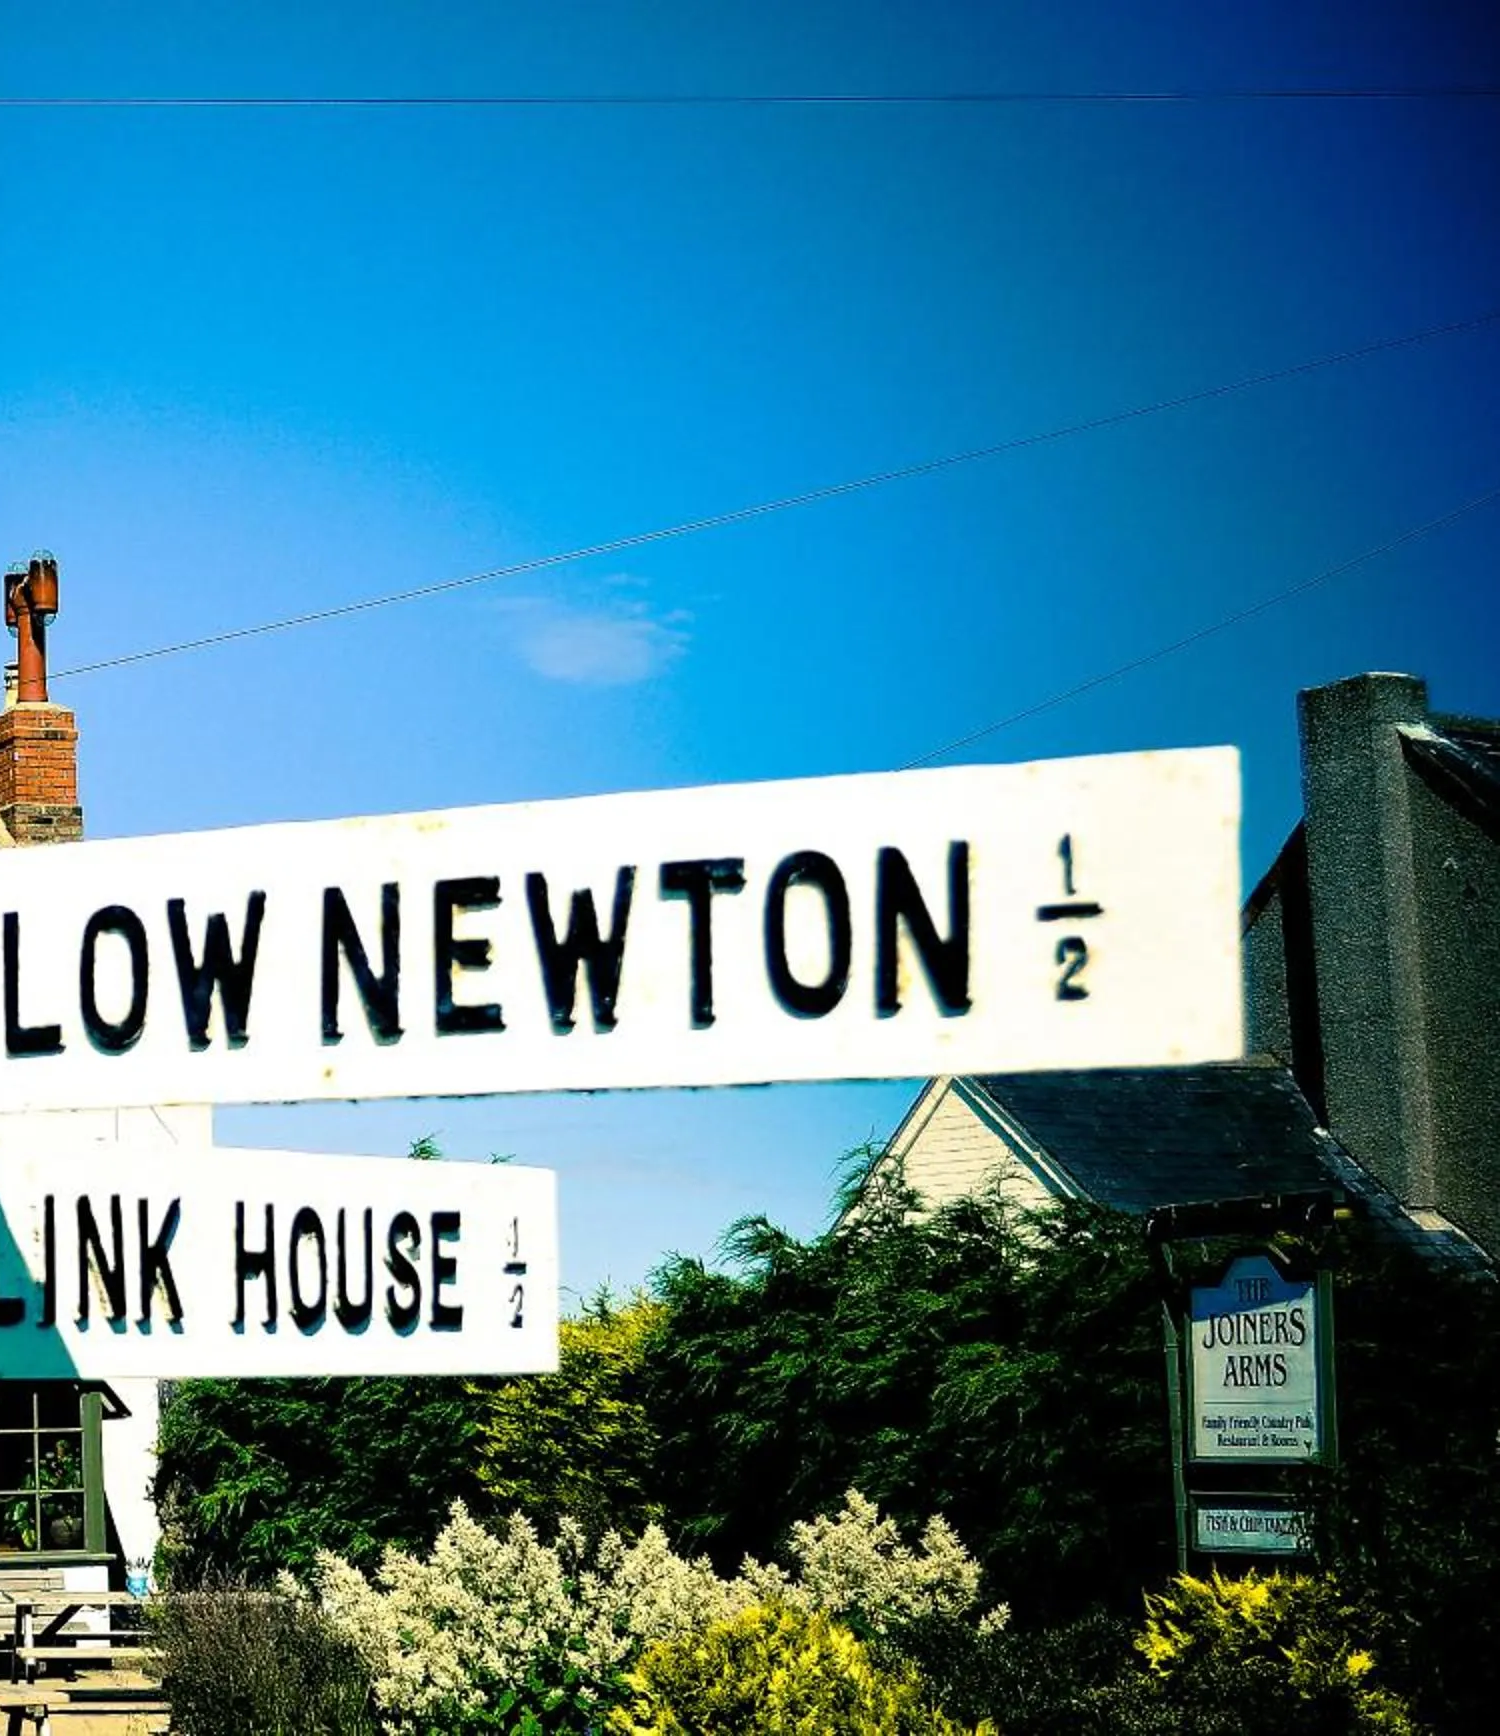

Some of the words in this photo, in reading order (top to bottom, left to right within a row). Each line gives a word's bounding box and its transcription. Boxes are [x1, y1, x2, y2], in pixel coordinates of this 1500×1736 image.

[3, 890, 266, 1059] LOW
[321, 838, 975, 1047] NEWTON
[230, 1201, 464, 1336] HOUSE
[1235, 1277, 1270, 1301] THE
[1203, 1308, 1306, 1349] JOINERS
[1223, 1354, 1288, 1388] ARMS
[1202, 1415, 1227, 1432] Family
[1261, 1434, 1269, 1447] &
[1271, 1434, 1299, 1447] Rooms
